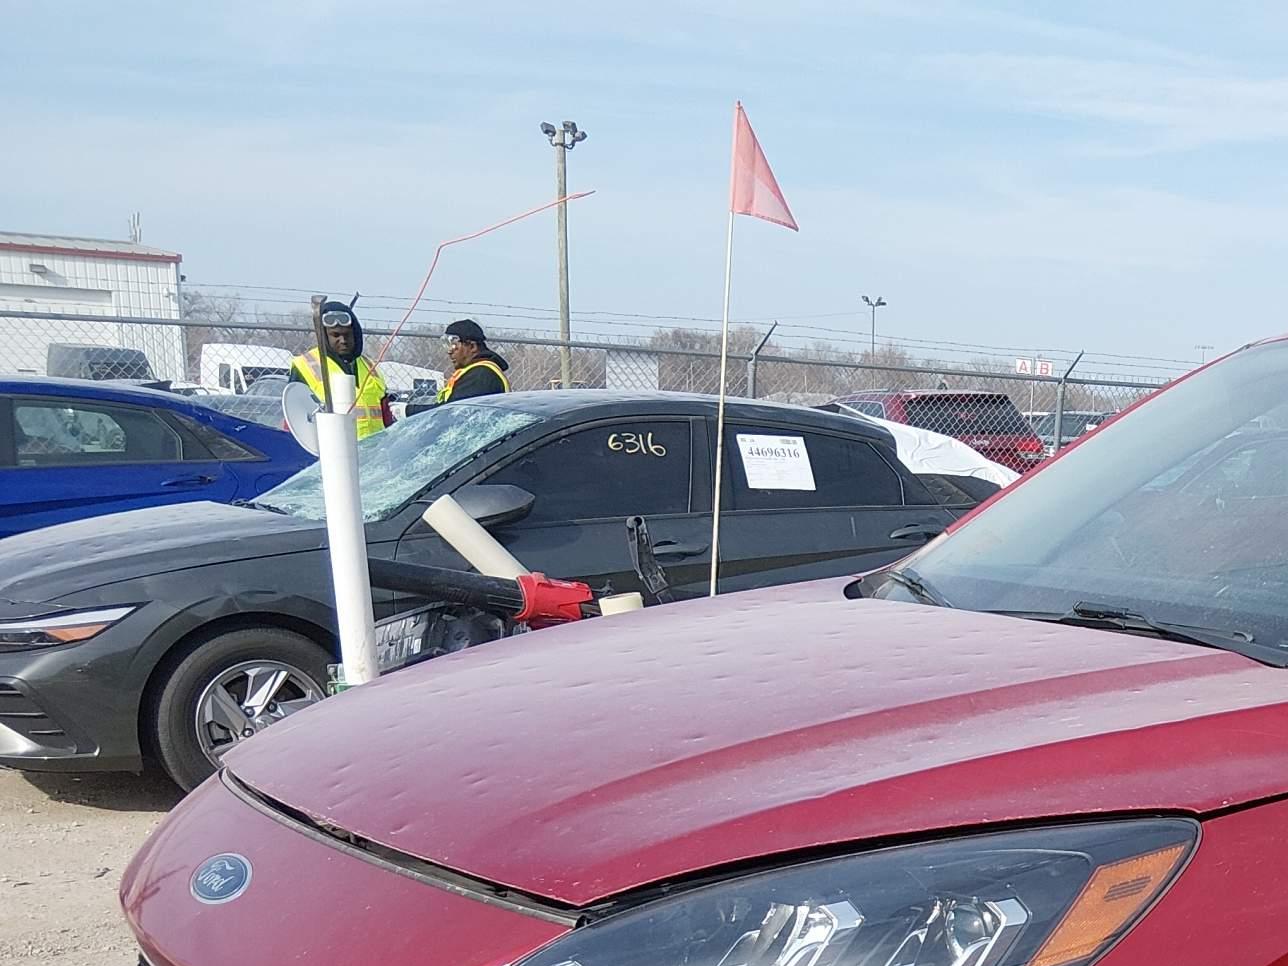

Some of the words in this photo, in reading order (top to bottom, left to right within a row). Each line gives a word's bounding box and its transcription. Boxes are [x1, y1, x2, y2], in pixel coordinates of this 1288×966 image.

[1019, 361, 1028, 372] A
[1040, 363, 1049, 374] B
[608, 433, 665, 456] 6316
[747, 446, 800, 459] 44696316
[198, 860, 235, 892] Ford
